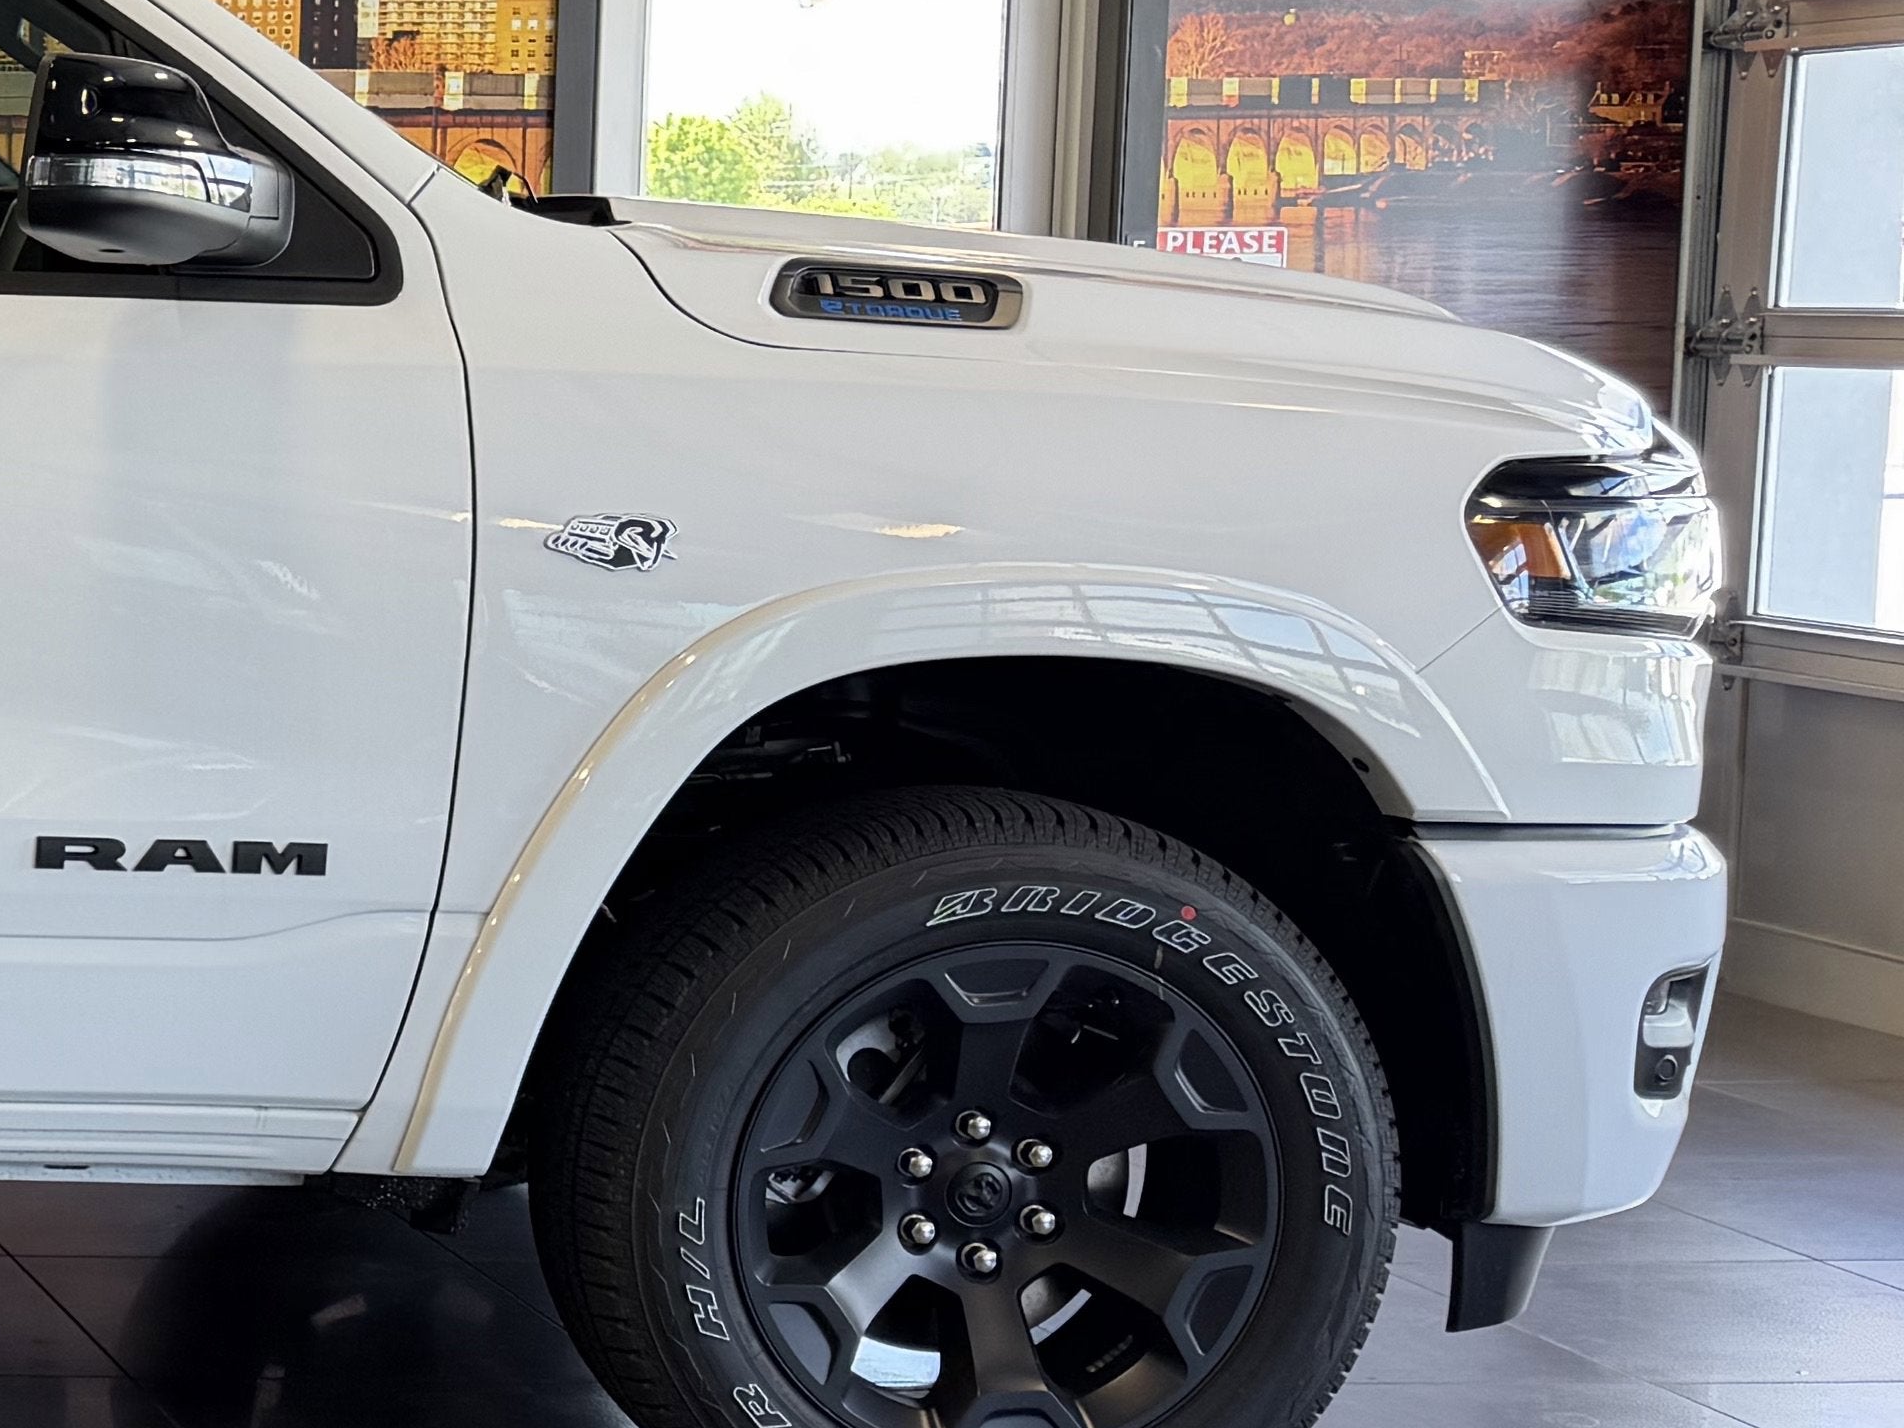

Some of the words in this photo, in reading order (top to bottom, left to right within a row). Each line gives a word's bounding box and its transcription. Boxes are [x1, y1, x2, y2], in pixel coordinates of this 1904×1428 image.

[1166, 231, 1278, 254] PLEASE
[810, 273, 987, 304] 1500
[34, 836, 328, 876] RAM
[925, 884, 1354, 1239] BRIDGESTONE
[675, 1195, 730, 1342] H/L
